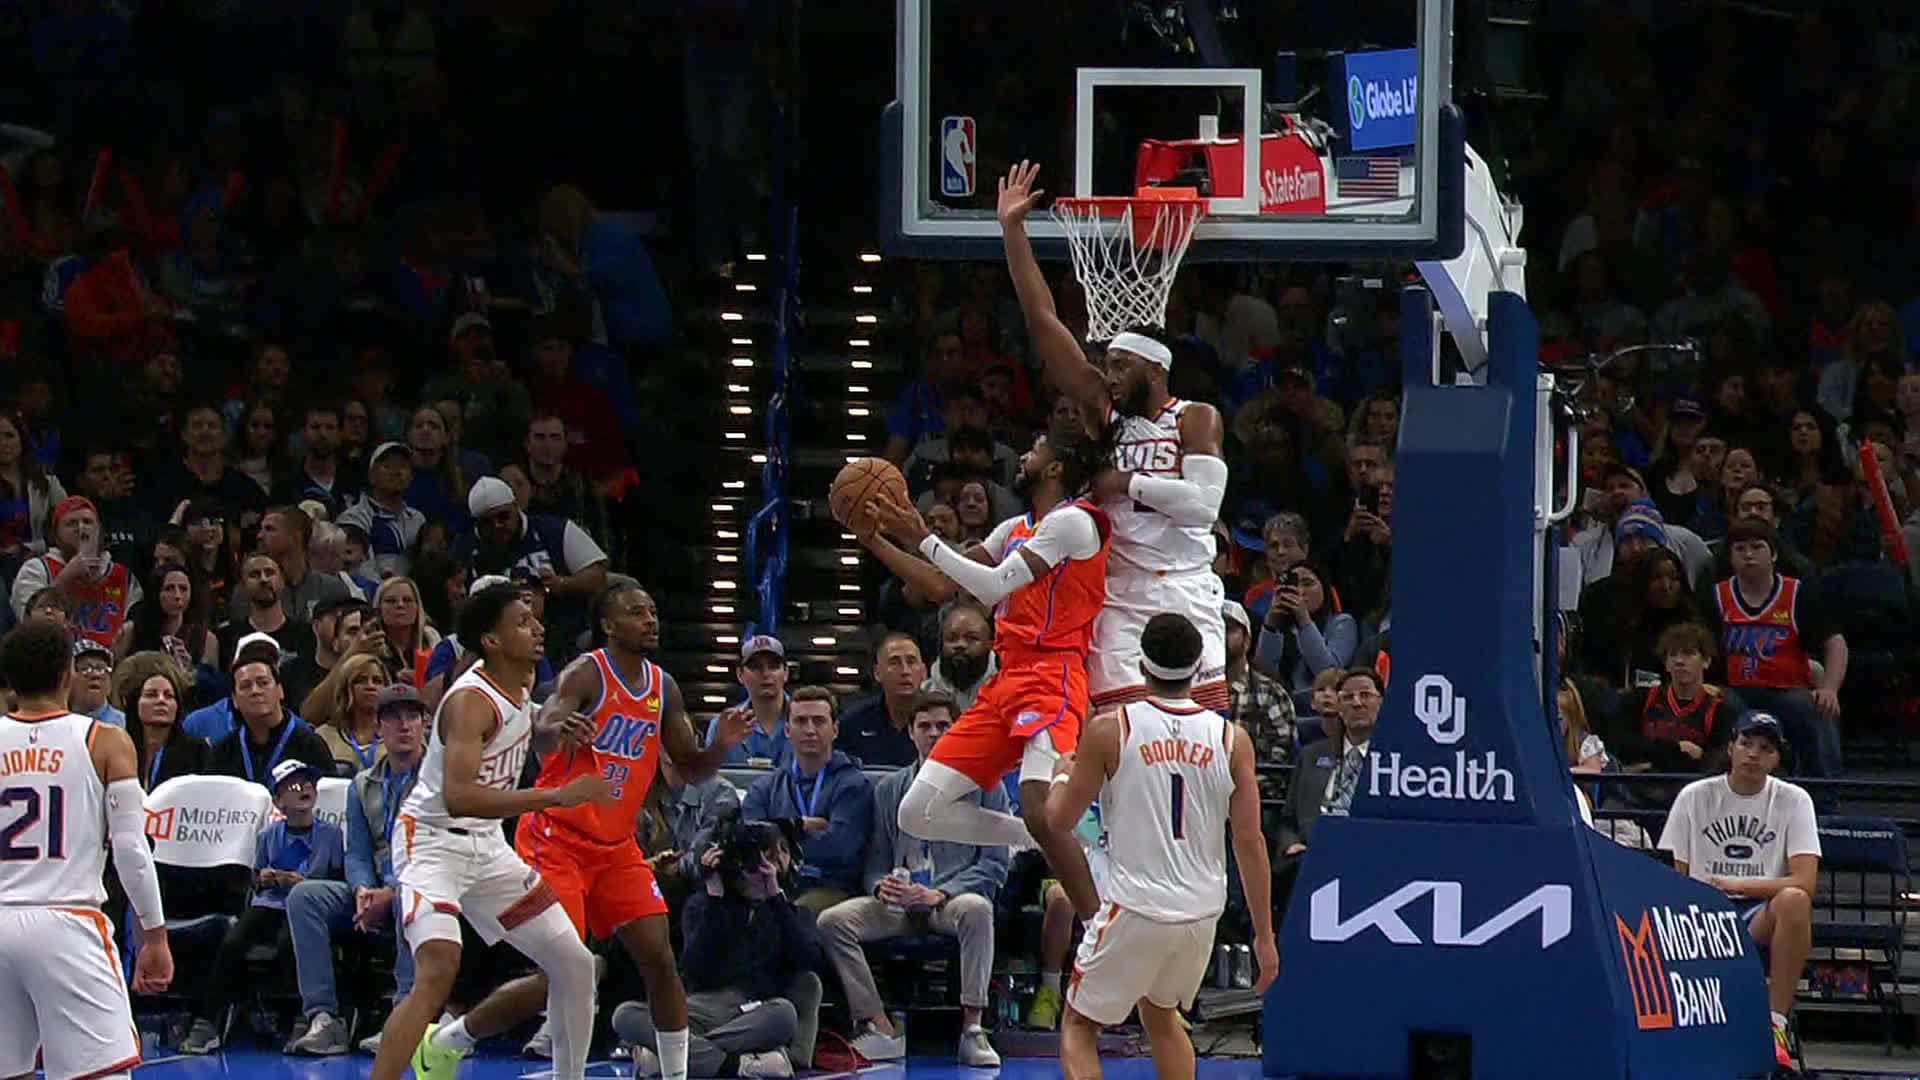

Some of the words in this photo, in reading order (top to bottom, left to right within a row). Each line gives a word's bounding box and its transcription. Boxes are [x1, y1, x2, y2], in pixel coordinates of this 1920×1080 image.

[1366, 80, 1401, 120] Globe
[1414, 674, 1466, 744] OU
[592, 714, 657, 760] OKC
[1139, 739, 1214, 769] BOOKER
[1, 747, 65, 777] JONES
[1368, 750, 1516, 801] Health
[0, 786, 65, 861] 21
[1171, 773, 1185, 841] 1
[1702, 814, 1776, 849] THUNDER
[1310, 877, 1572, 949] KIA
